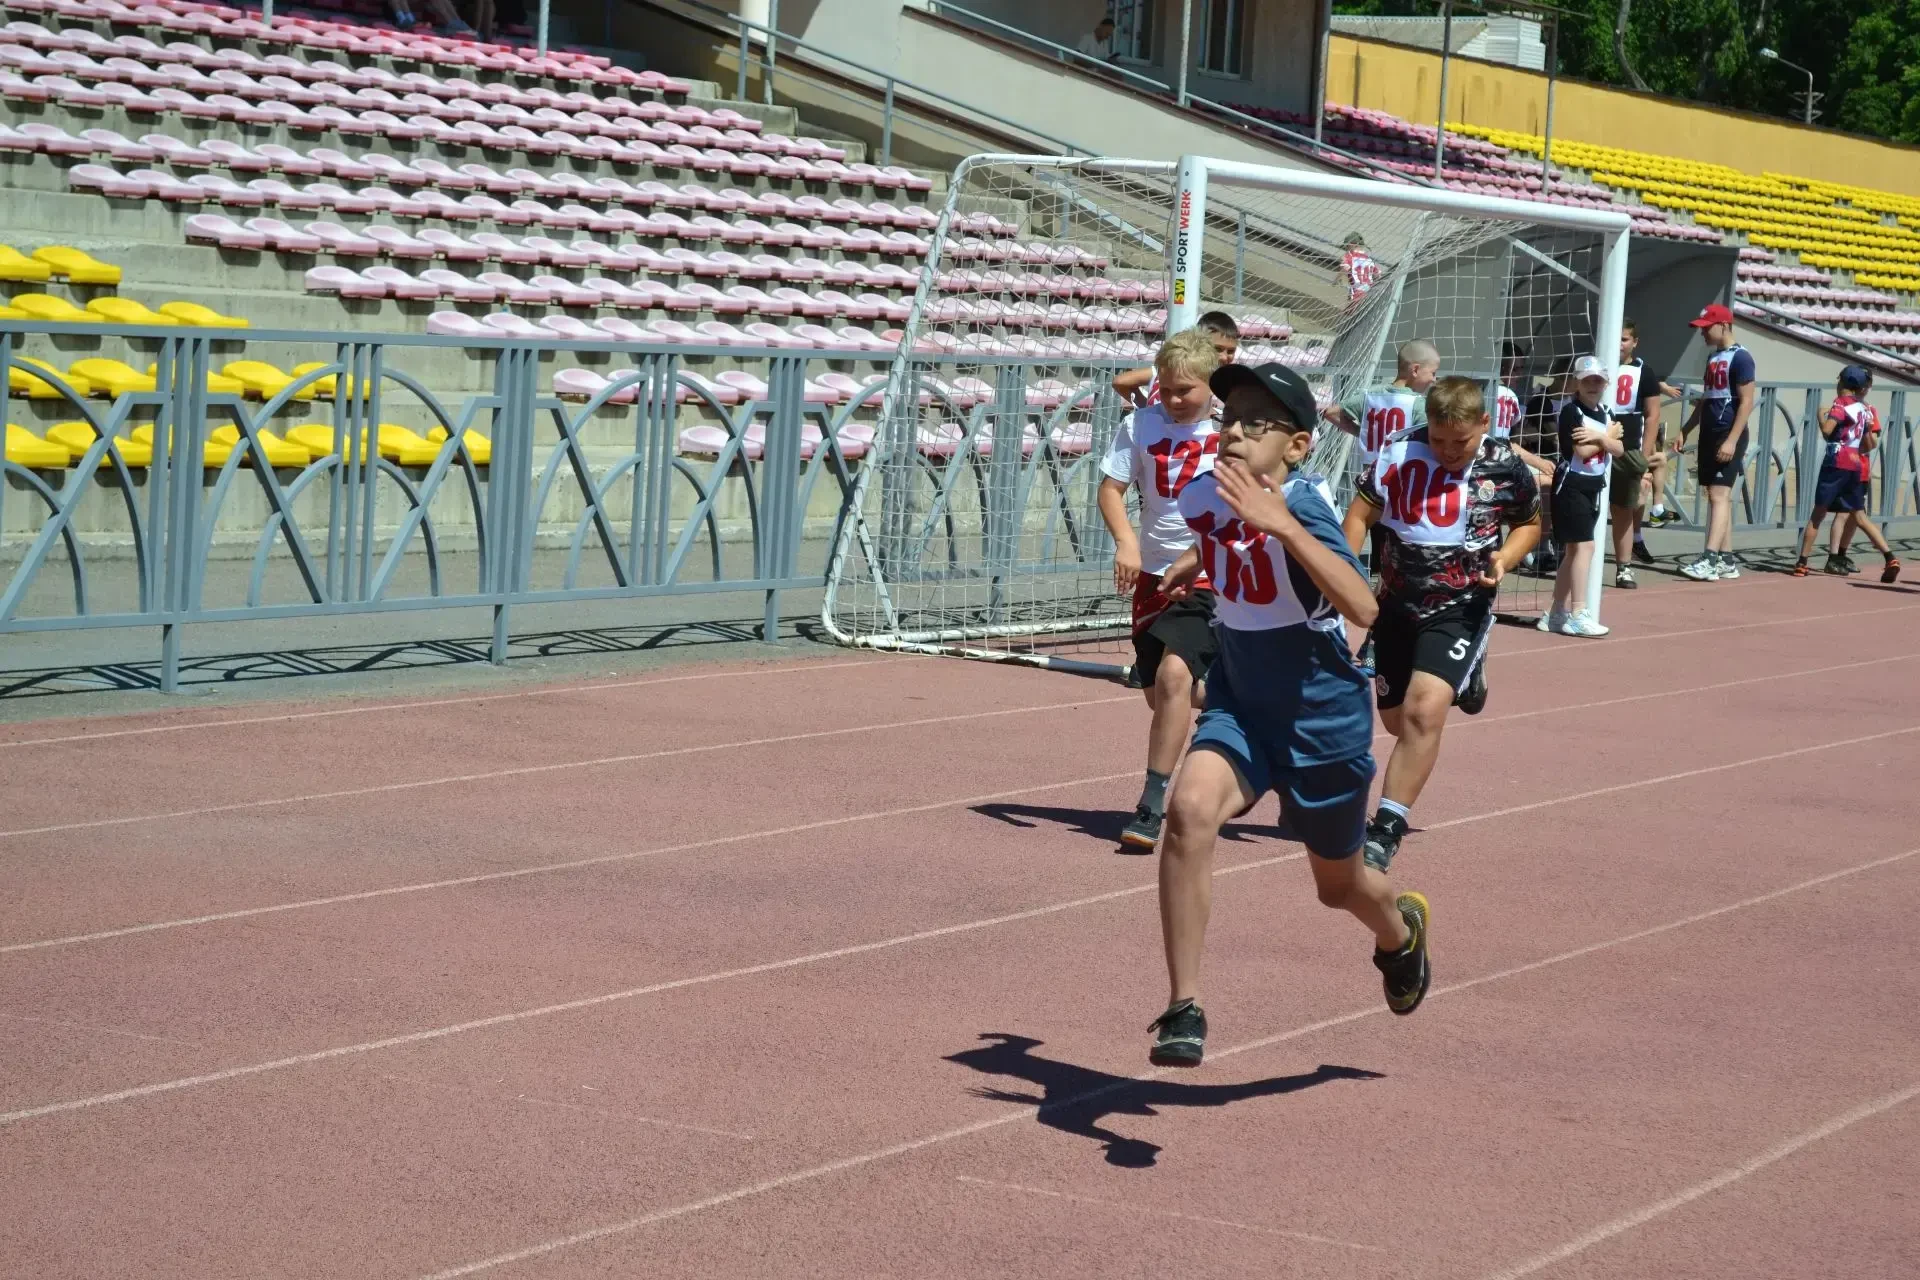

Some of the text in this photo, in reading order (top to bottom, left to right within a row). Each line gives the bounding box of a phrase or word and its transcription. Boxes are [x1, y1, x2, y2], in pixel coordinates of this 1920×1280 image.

[1177, 191, 1192, 273] SPORTWERK
[1381, 459, 1461, 528] 106
[1448, 638, 1471, 661] 5
